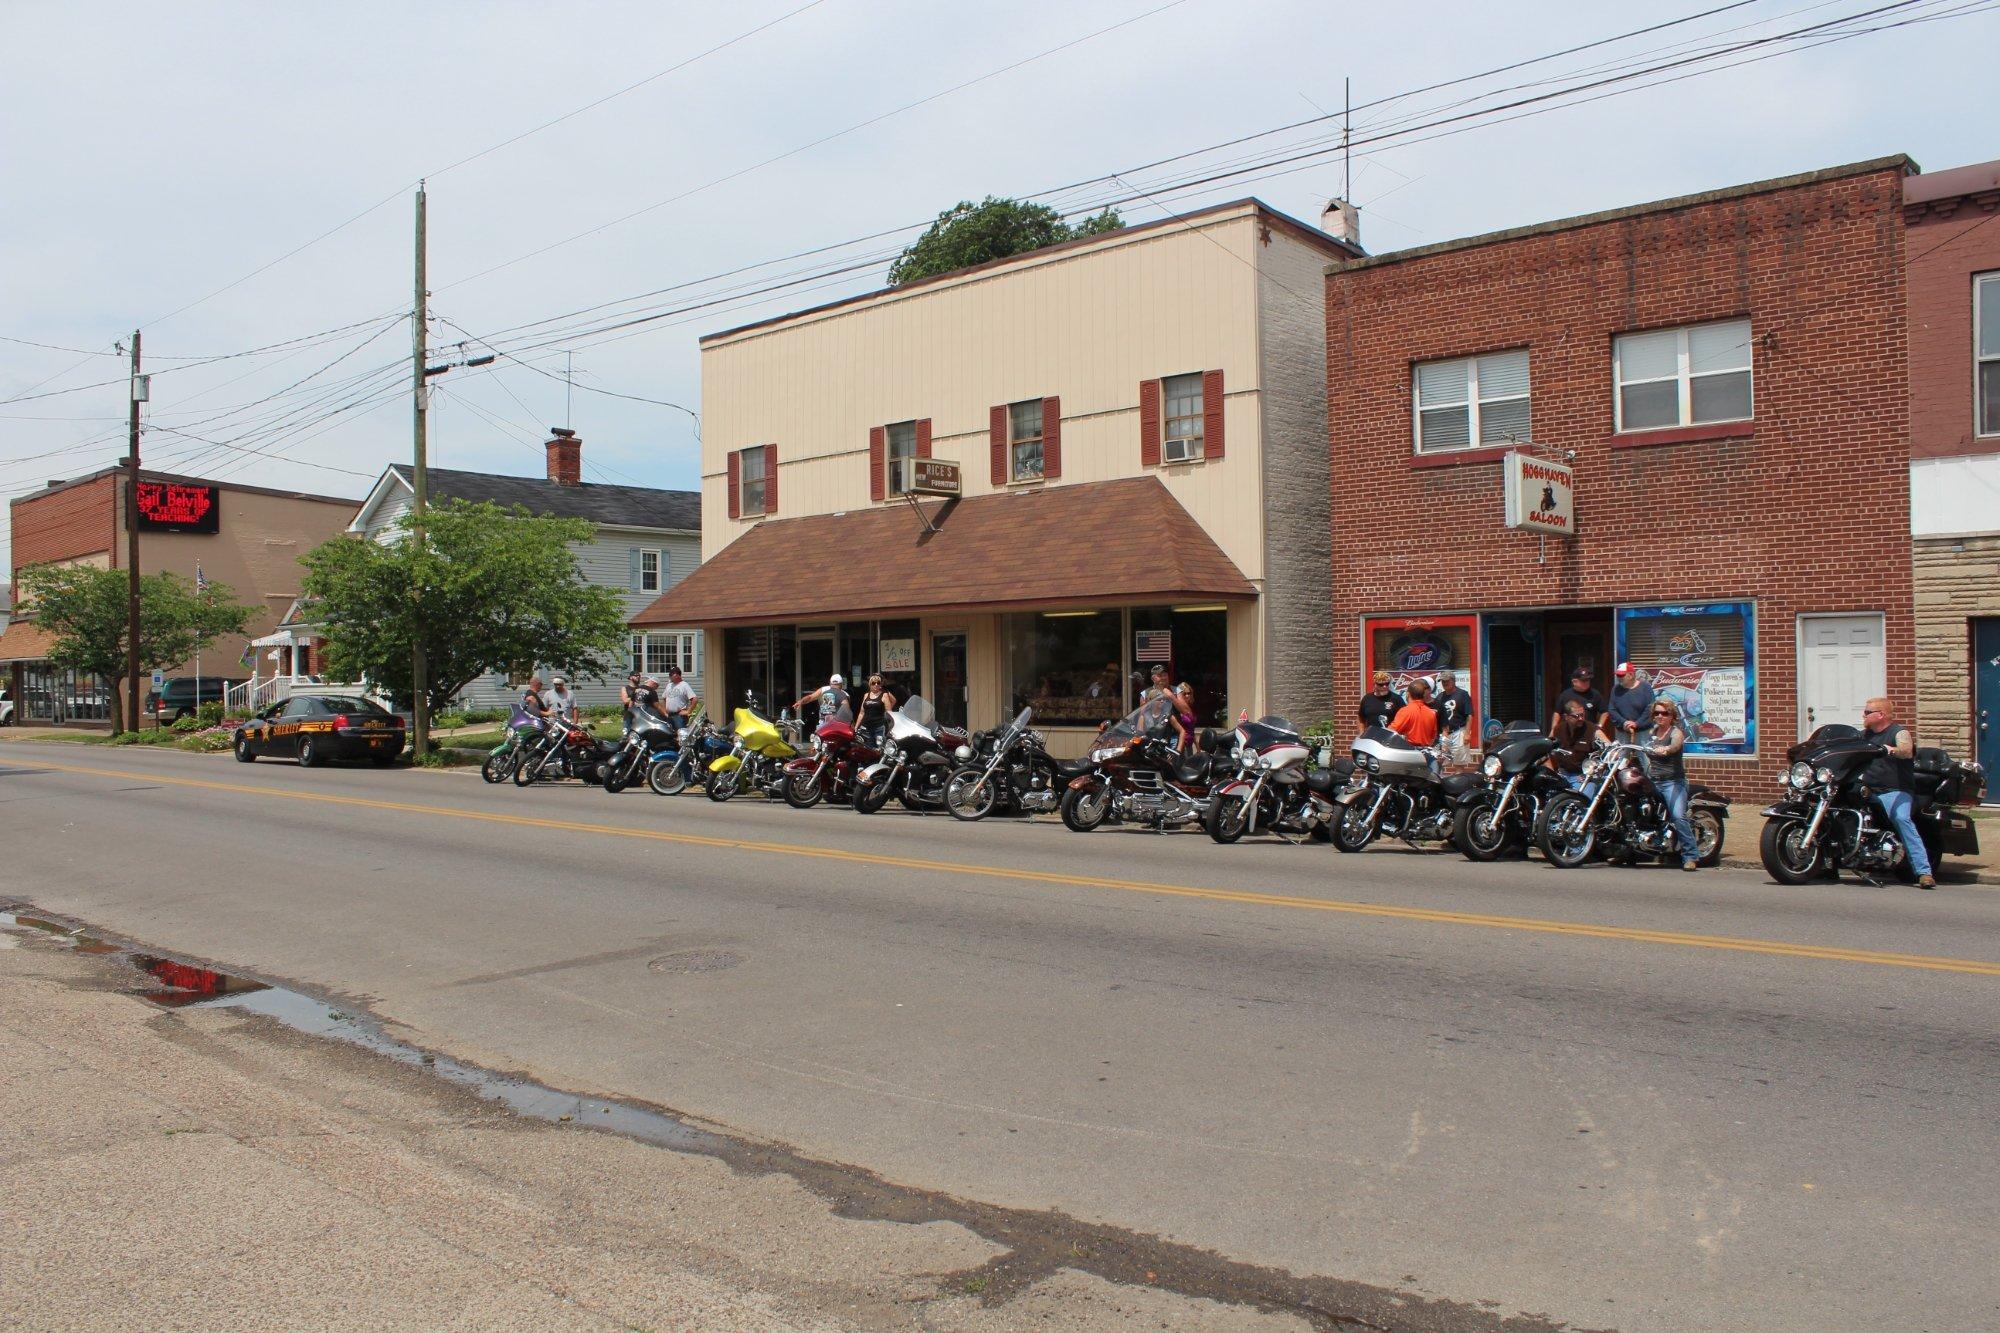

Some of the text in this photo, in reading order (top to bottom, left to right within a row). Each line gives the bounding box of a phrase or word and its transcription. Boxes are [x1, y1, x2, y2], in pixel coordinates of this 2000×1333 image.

[926, 464, 952, 477] RICE'S
[167, 483, 209, 494] Retirement
[931, 480, 958, 489] FURNITURE
[137, 490, 210, 509] Gail Belville
[158, 506, 190, 515] YEARS
[194, 508, 206, 516] OF
[1530, 511, 1567, 527] SALOON
[899, 648, 911, 657] OFF
[272, 723, 300, 736] SHERIFF
